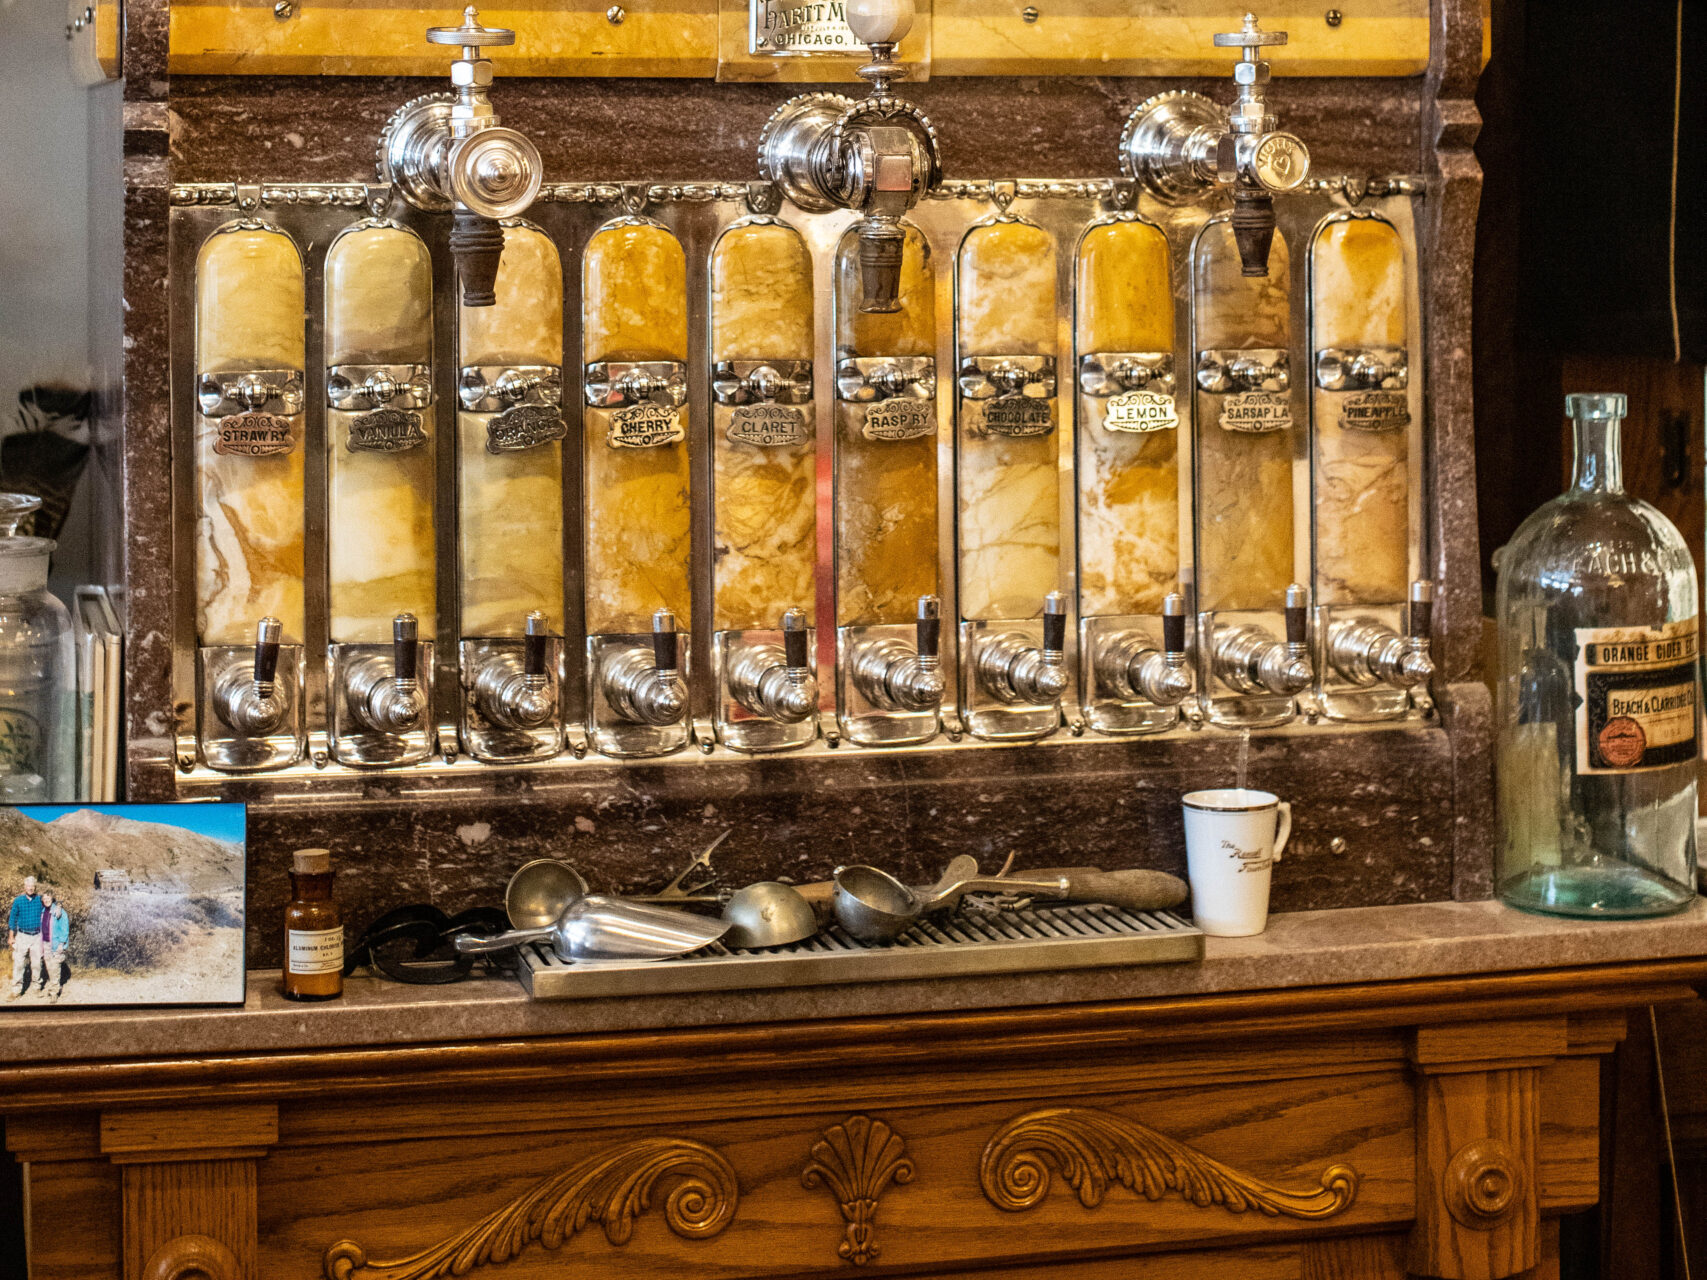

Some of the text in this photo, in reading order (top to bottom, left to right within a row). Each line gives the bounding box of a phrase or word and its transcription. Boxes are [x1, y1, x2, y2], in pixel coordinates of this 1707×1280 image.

[776, 33, 848, 46] CHICAGO,
[987, 411, 1049, 424] CHOCOLATE
[1116, 407, 1168, 420] LEMON
[1347, 406, 1407, 418] PINEAPPLE
[357, 422, 421, 440] VANILLA
[620, 418, 673, 434] CHERRY
[741, 421, 798, 434] CLARET
[1603, 646, 1650, 663] ORANGE
[1656, 641, 1682, 660] CIDER
[1612, 698, 1643, 716] BEACH
